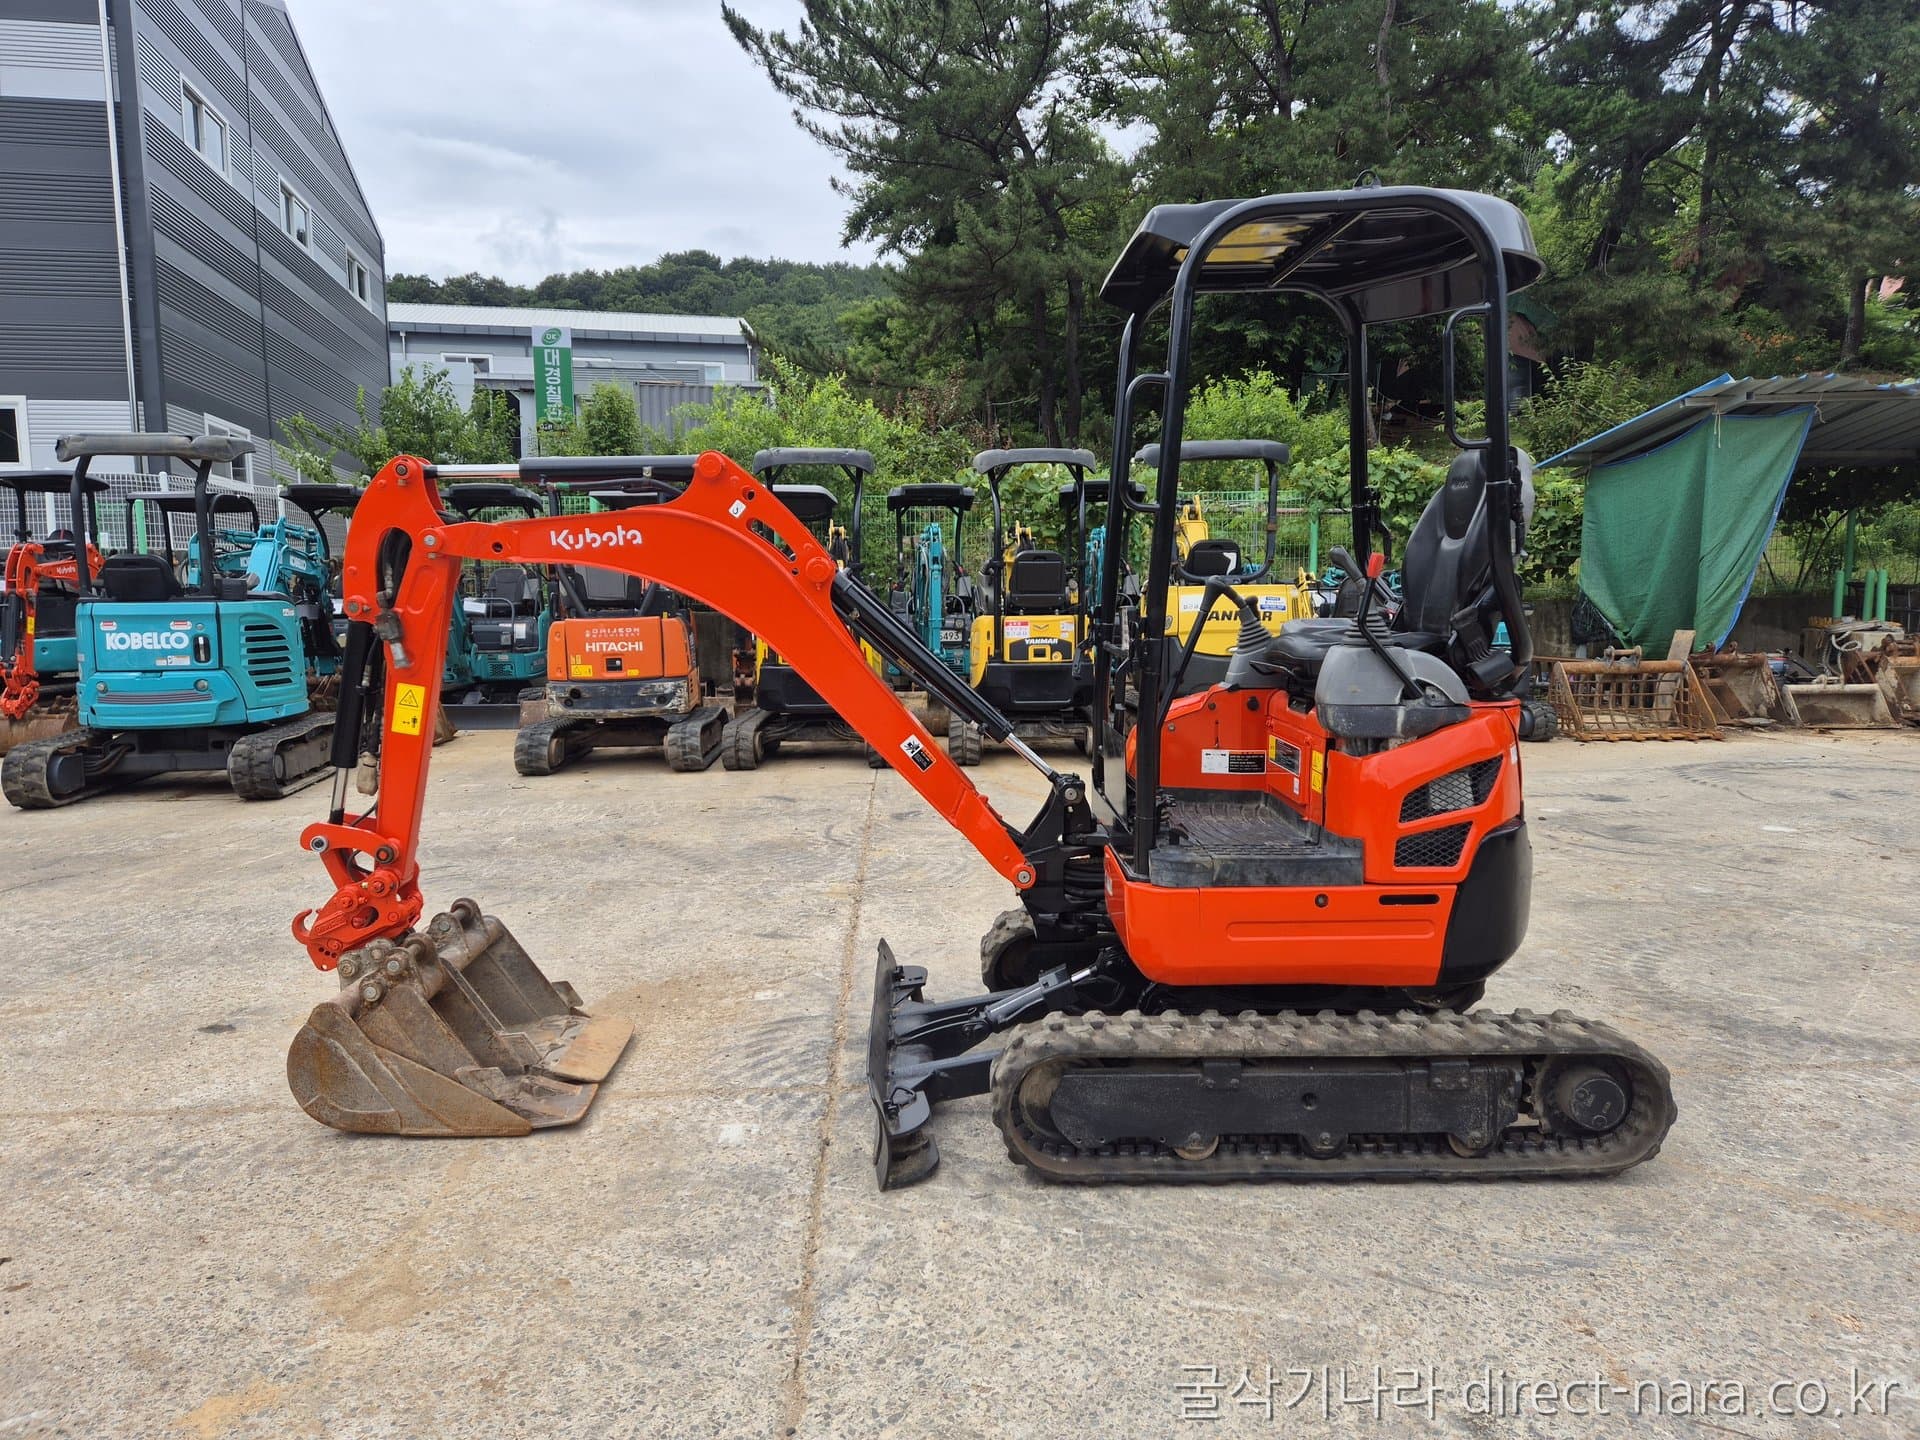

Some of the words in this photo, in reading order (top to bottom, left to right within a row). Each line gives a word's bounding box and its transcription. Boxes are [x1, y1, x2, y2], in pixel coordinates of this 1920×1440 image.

[549, 525, 643, 550] Kubota
[105, 632, 189, 650] KOBELCO
[585, 641, 643, 653] HITACHI
